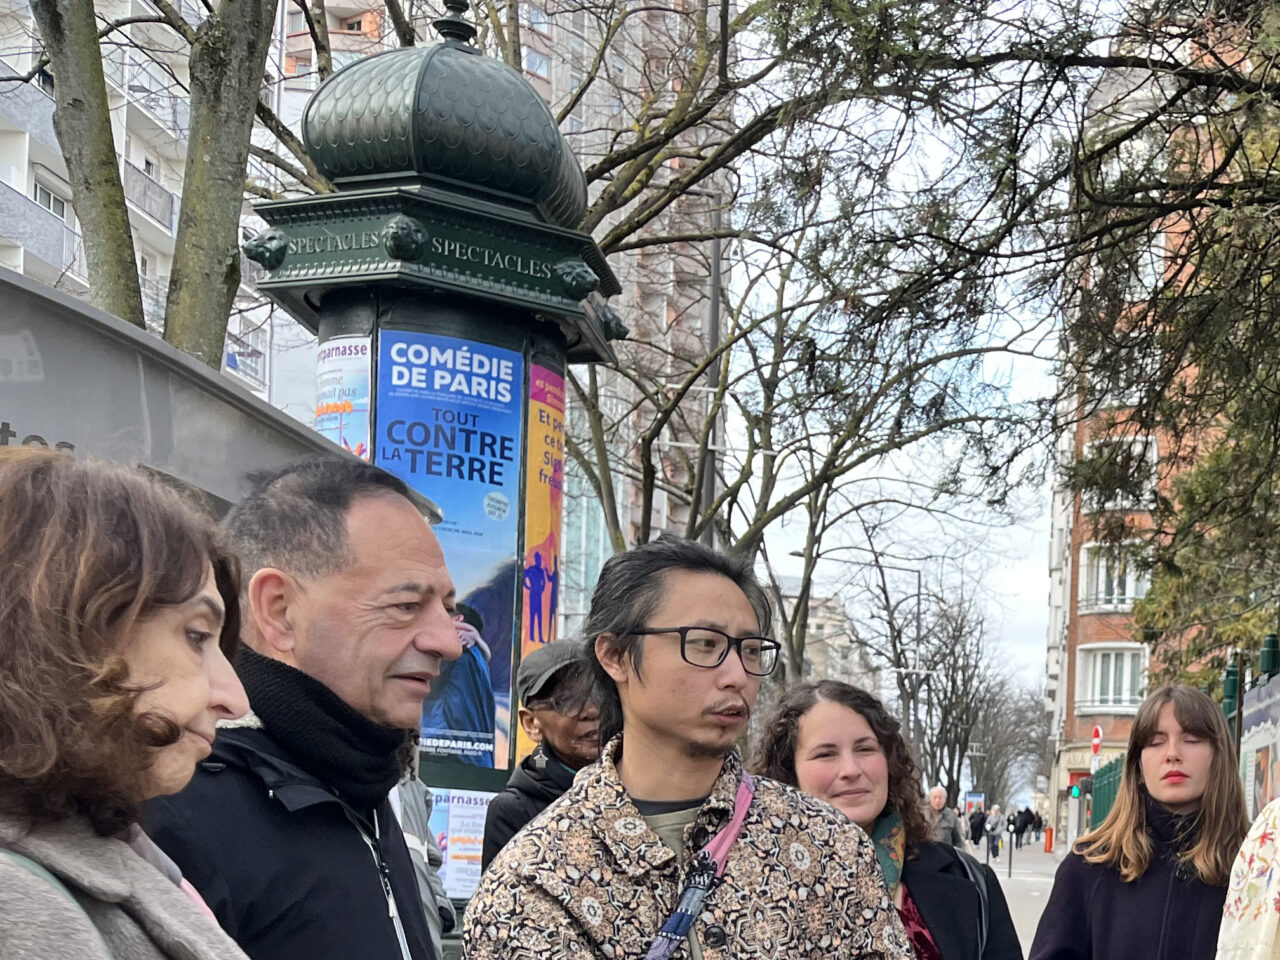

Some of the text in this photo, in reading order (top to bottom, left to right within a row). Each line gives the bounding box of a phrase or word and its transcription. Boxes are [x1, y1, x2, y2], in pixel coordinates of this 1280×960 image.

[288, 231, 379, 255] SPECTACLES
[431, 237, 552, 279] SPECTACLES
[390, 342, 514, 382] COMÉDIE
[390, 364, 427, 388] DE
[433, 371, 512, 404] PARIS
[432, 407, 480, 428] TOUT
[538, 408, 551, 427] Et
[386, 418, 515, 462] CONTRE
[382, 446, 504, 487] LA TERRE
